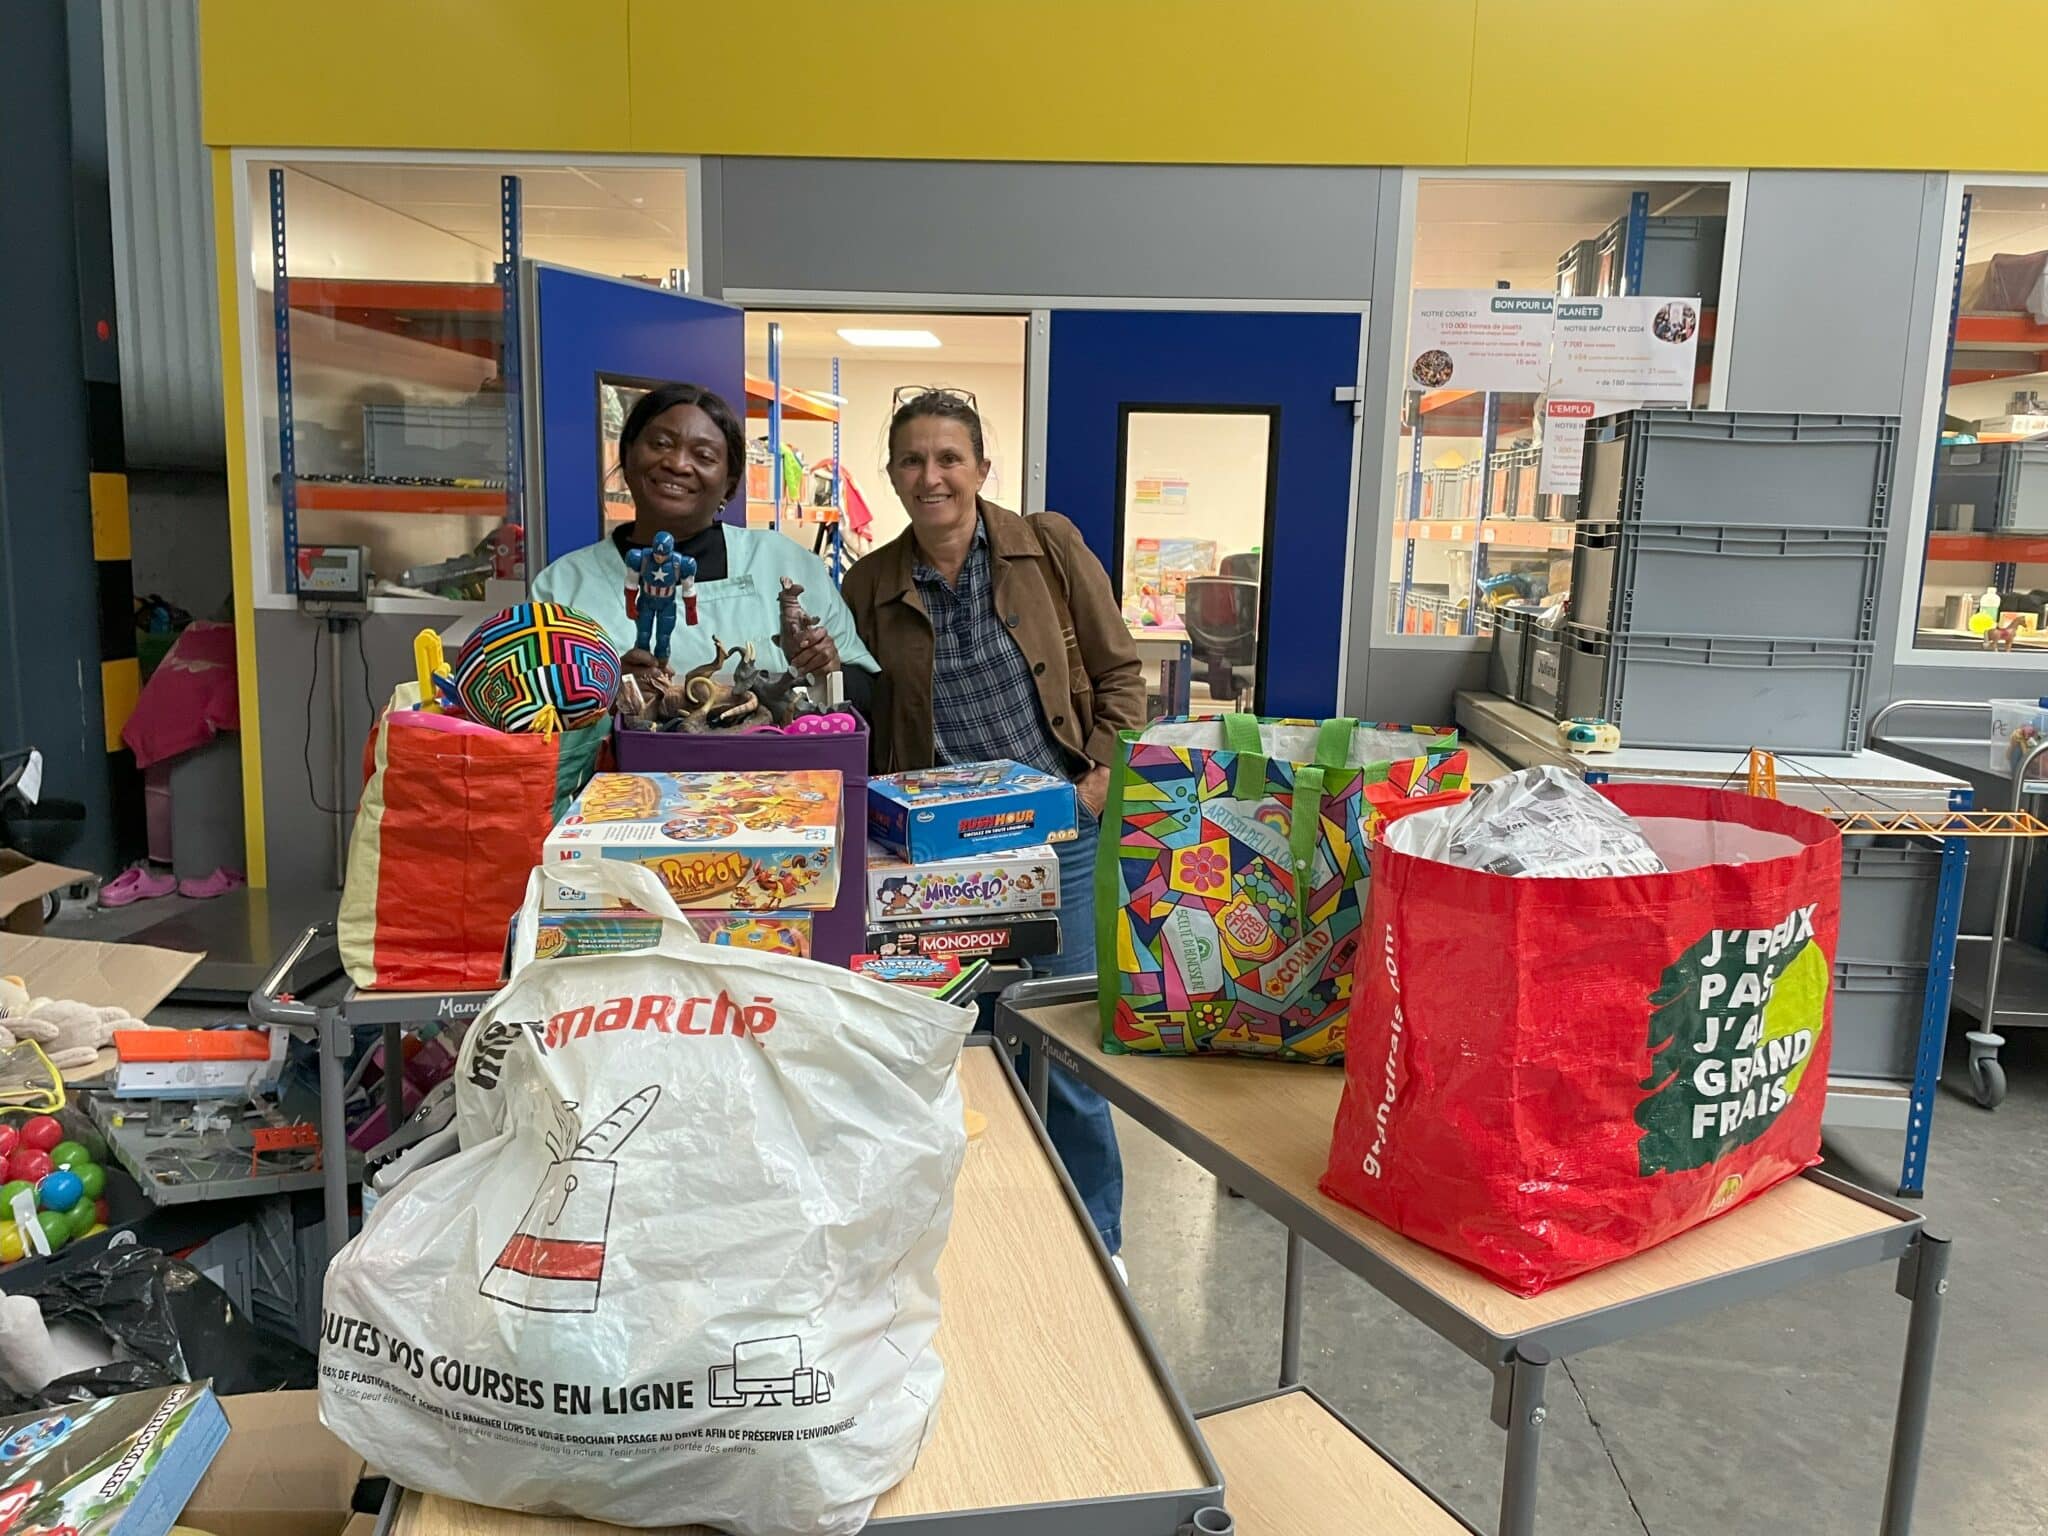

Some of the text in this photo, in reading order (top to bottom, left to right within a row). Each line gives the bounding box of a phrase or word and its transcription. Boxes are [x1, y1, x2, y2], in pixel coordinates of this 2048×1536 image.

[1495, 301, 1553, 310] BON POUR LA
[1558, 305, 1600, 316] PLANÈTE
[1549, 404, 1592, 414] L'EMPLOI
[995, 808, 1036, 826] HOUR
[1204, 804, 1282, 861] ARTISTI DELLA
[922, 931, 1007, 951] MONOPOLY
[1276, 930, 1330, 984] CONAD
[1699, 964, 1774, 1010] PAS
[1363, 923, 1404, 1179] grandfraiscom
[1693, 1029, 1812, 1097] GRAND
[383, 1334, 424, 1379] VOS
[430, 1355, 545, 1410] COURSES
[553, 1383, 592, 1416] EN
[602, 1380, 694, 1415] LIGNE
[338, 1369, 350, 1381] DE
[452, 1411, 461, 1421] LE
[462, 1413, 501, 1429] RAMENER
[503, 1421, 524, 1434] LORS
[525, 1426, 537, 1437] DE
[538, 1428, 565, 1442] VOTRE
[566, 1434, 615, 1445] PROCHAIN
[617, 1433, 659, 1444] PASSAGE
[660, 1432, 673, 1442] AU
[674, 1428, 703, 1441] DRIVE
[705, 1428, 727, 1439] AFIN
[728, 1428, 741, 1440] DE
[742, 1428, 794, 1442] PRÉSERVER
[704, 1442, 720, 1454] des
